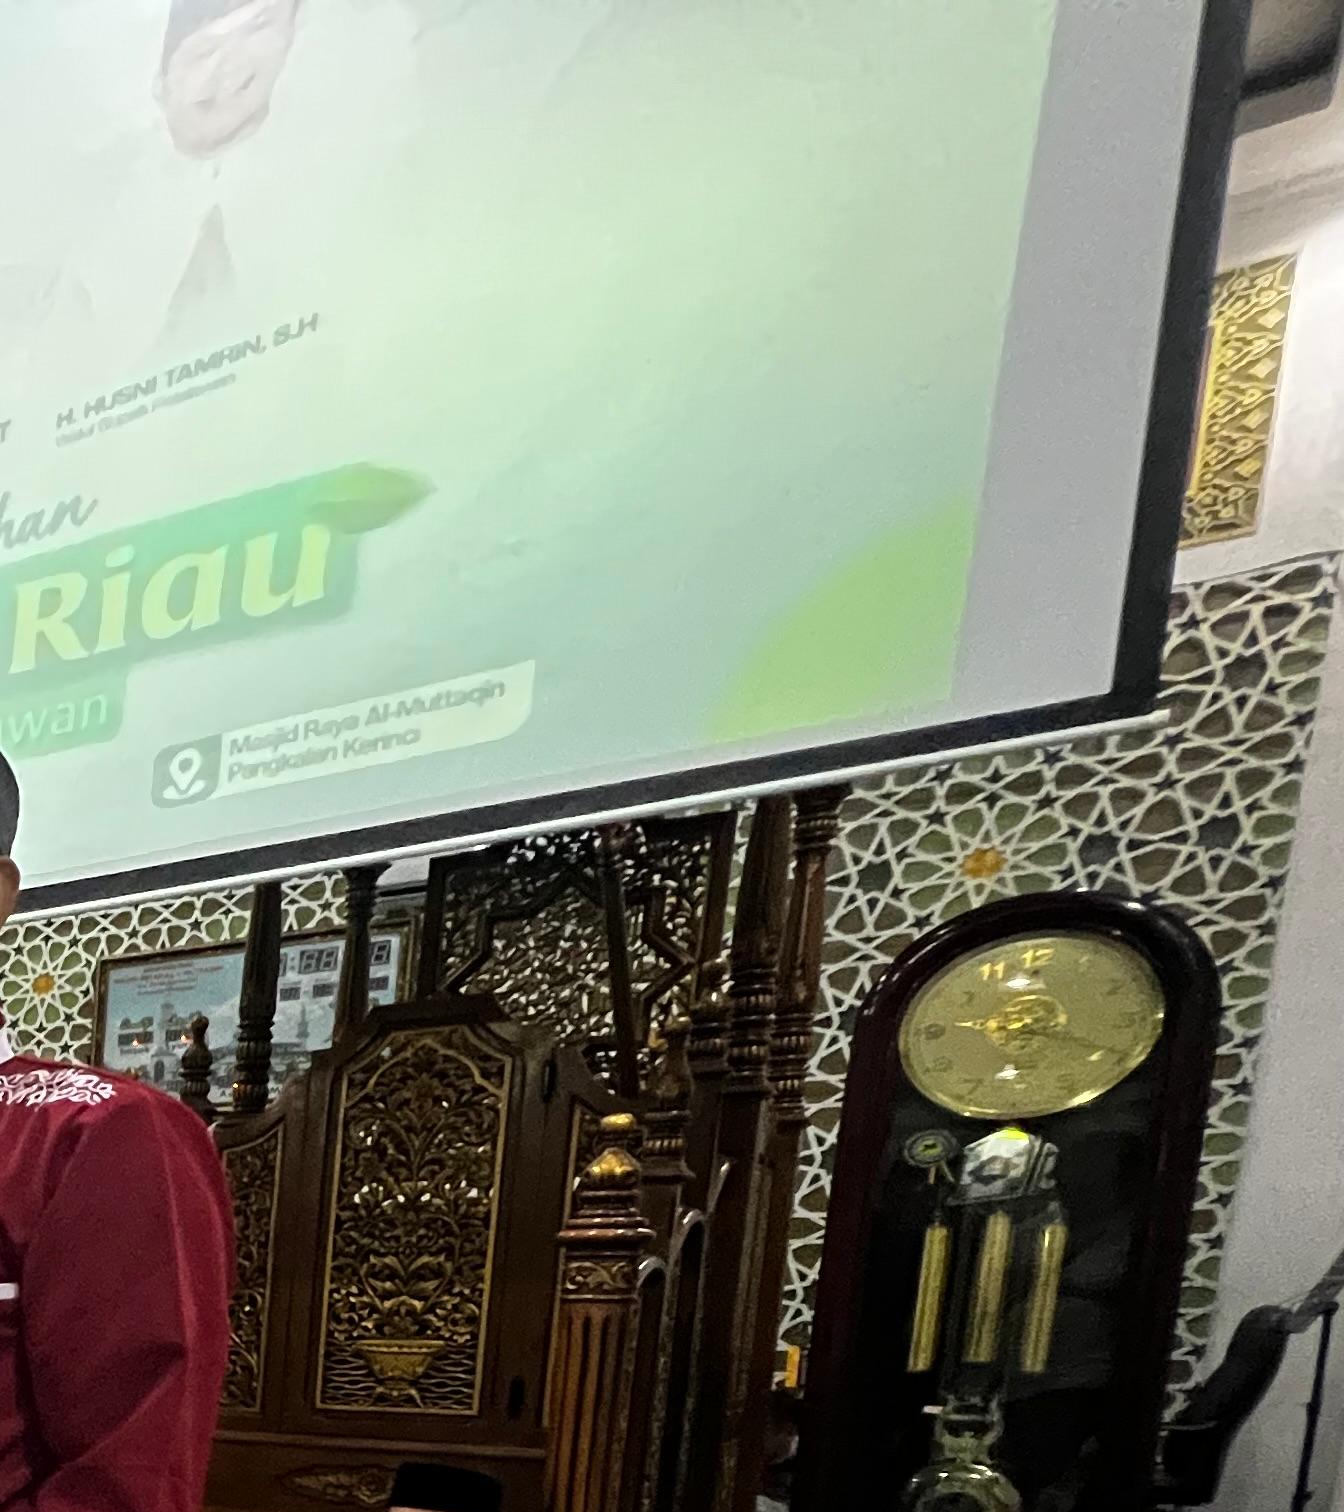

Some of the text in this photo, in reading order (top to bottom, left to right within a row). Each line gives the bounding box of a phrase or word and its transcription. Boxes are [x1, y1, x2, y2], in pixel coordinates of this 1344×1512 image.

[7, 521, 331, 674] Riau
[227, 678, 507, 757] Masjid Raya Al-Muttaqin
[227, 744, 339, 783] Pangkalan
[979, 962, 1006, 981] 11
